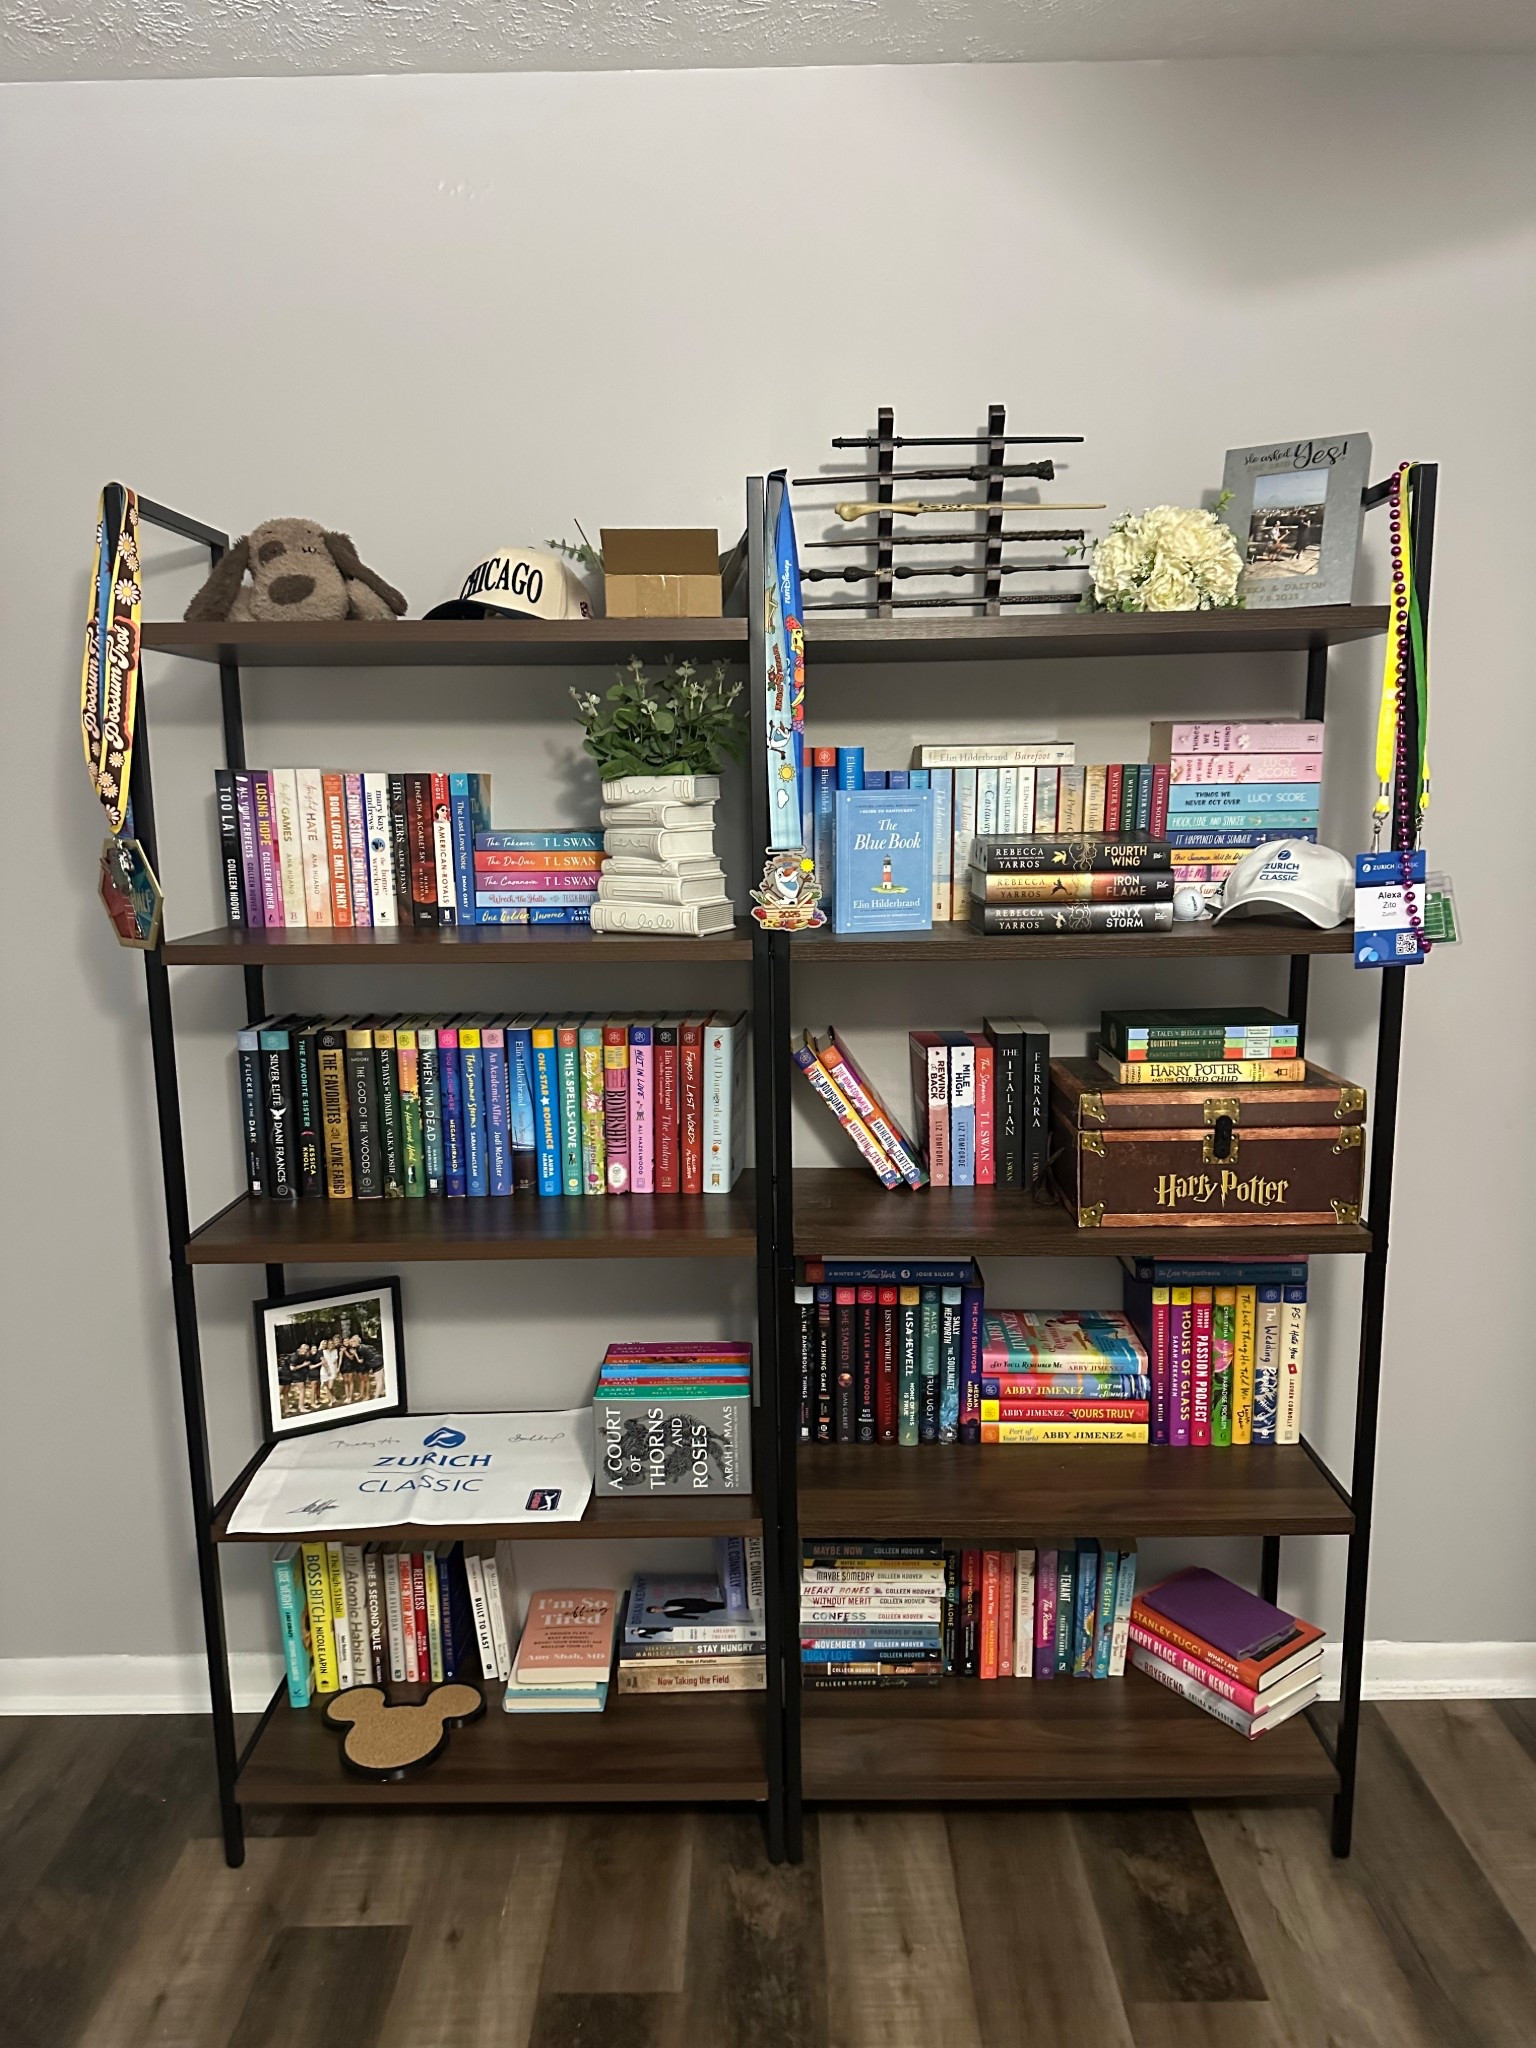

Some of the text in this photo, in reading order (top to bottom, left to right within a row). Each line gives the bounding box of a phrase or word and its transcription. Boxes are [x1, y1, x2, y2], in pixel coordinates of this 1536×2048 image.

[1293, 441, 1348, 469] Yes!
[459, 557, 543, 603] CHICAGO
[780, 559, 793, 604] runDisney
[84, 656, 100, 740] Possum
[104, 624, 130, 750] Possum Trot
[940, 750, 1051, 767] Elin Hilderbrand Barefoot
[219, 787, 232, 811] TOO
[1110, 771, 1120, 804] WINTER
[1247, 792, 1307, 803] LUCY SCORE
[255, 782, 272, 847] LOSING HOPE
[329, 795, 344, 850] BOOK LOVERS
[878, 818, 898, 831] The
[486, 837, 596, 847] The Takeover T L SWAN
[853, 832, 922, 851] Blue Book
[995, 848, 1045, 857] REBECCA
[1104, 846, 1148, 857] FOURTH
[999, 860, 1041, 869] YARROS
[1111, 856, 1141, 867] WING
[1264, 862, 1300, 872] ZURICH
[1372, 863, 1395, 871] ZURICH
[227, 859, 241, 921] COLLEEN HOOVER
[262, 852, 275, 910] COLLEEN HOOVER
[333, 855, 349, 910] EMILY HENRY
[996, 878, 1046, 887] REBECCA
[1106, 885, 1148, 897] FLAME
[1113, 875, 1140, 886] IRON
[1259, 873, 1298, 882] CLASSIC
[852, 898, 921, 910] Elin Hilderbrand
[1000, 890, 1042, 899] YARROS
[1378, 891, 1402, 899] Alexa
[995, 908, 1045, 917] REBECCA
[998, 921, 1041, 930] YARROS
[1105, 917, 1144, 929] STORM
[1109, 908, 1141, 919] ONYX
[1002, 1049, 1019, 1057] THE
[269, 1053, 281, 1106] SILVER ELITE
[937, 1060, 946, 1101] REWIND
[955, 1072, 964, 1097] HIGH
[963, 1064, 971, 1088] MILE
[1150, 1062, 1243, 1077] HARRY POTTER
[1175, 1076, 1210, 1084] CURSED
[1210, 1075, 1239, 1083] CHILD
[322, 1052, 342, 1125] THE FAVORITES
[422, 1052, 436, 1142] WHEN I'M DEAD
[564, 1052, 578, 1150] THIS SPELLS LOVE
[684, 1050, 697, 1145] FAMOUS LAST WORDS
[811, 1068, 848, 1115] THE BODYGUARD
[930, 1073, 938, 1100] BACK
[1005, 1060, 1014, 1136] ITALIAN
[1032, 1053, 1042, 1127] FERRARA
[356, 1066, 371, 1174] THE GOD OF THE WOODS
[543, 1106, 554, 1150] ROMANCE
[606, 1089, 627, 1156] BOMBSHELL
[275, 1121, 287, 1183] DANI FRANCIS
[330, 1141, 347, 1195] LAYNE FARGO
[1154, 1170, 1291, 1208] Harry Potter
[905, 1311, 914, 1377] LISA JEWELL
[1180, 1310, 1192, 1421] HOUSE OF GLASS
[1195, 1335, 1209, 1423] PASSION PROJECT
[722, 1405, 733, 1438] MAAS
[1001, 1408, 1135, 1419] ABBY JIMENEZ YOURS TRULY
[671, 1417, 683, 1447] AND
[1042, 1431, 1123, 1440] ABBY JIMENEZ
[373, 1452, 492, 1467] ZURICH
[605, 1406, 624, 1491] A COURT
[648, 1407, 666, 1490] THORNS
[691, 1424, 709, 1489] ROSES
[630, 1454, 642, 1474] OF
[724, 1450, 734, 1488] SARAH
[358, 1474, 484, 1493] CLASSIC
[306, 1553, 326, 1623] BOSS BITCH
[413, 1568, 425, 1611] RELENTLESS
[803, 1586, 870, 1595] HEART BONES
[816, 1571, 875, 1581] MAYBE SOMEDAY
[1060, 1573, 1071, 1603] TENANT
[347, 1569, 368, 1664] Atomic Habits
[366, 1561, 382, 1651] THE 5 SECOND RULE
[538, 1597, 609, 1610] I'm So
[812, 1612, 866, 1621] CONFESS
[541, 1613, 601, 1627] Tired
[1132, 1609, 1201, 1657] STANLEY TUCCI
[315, 1626, 328, 1674] NICOLE LAPIN
[697, 1643, 753, 1654] STAY HUNGRY
[814, 1639, 866, 1649] NOVEMBER 9
[1129, 1624, 1154, 1650] HAPPY
[1153, 1639, 1179, 1665] PLACE
[657, 1674, 730, 1687] Now Taking the Field
[1143, 1661, 1185, 1695] BOYFRIEND
[1181, 1656, 1236, 1701] EMILY HENRY
